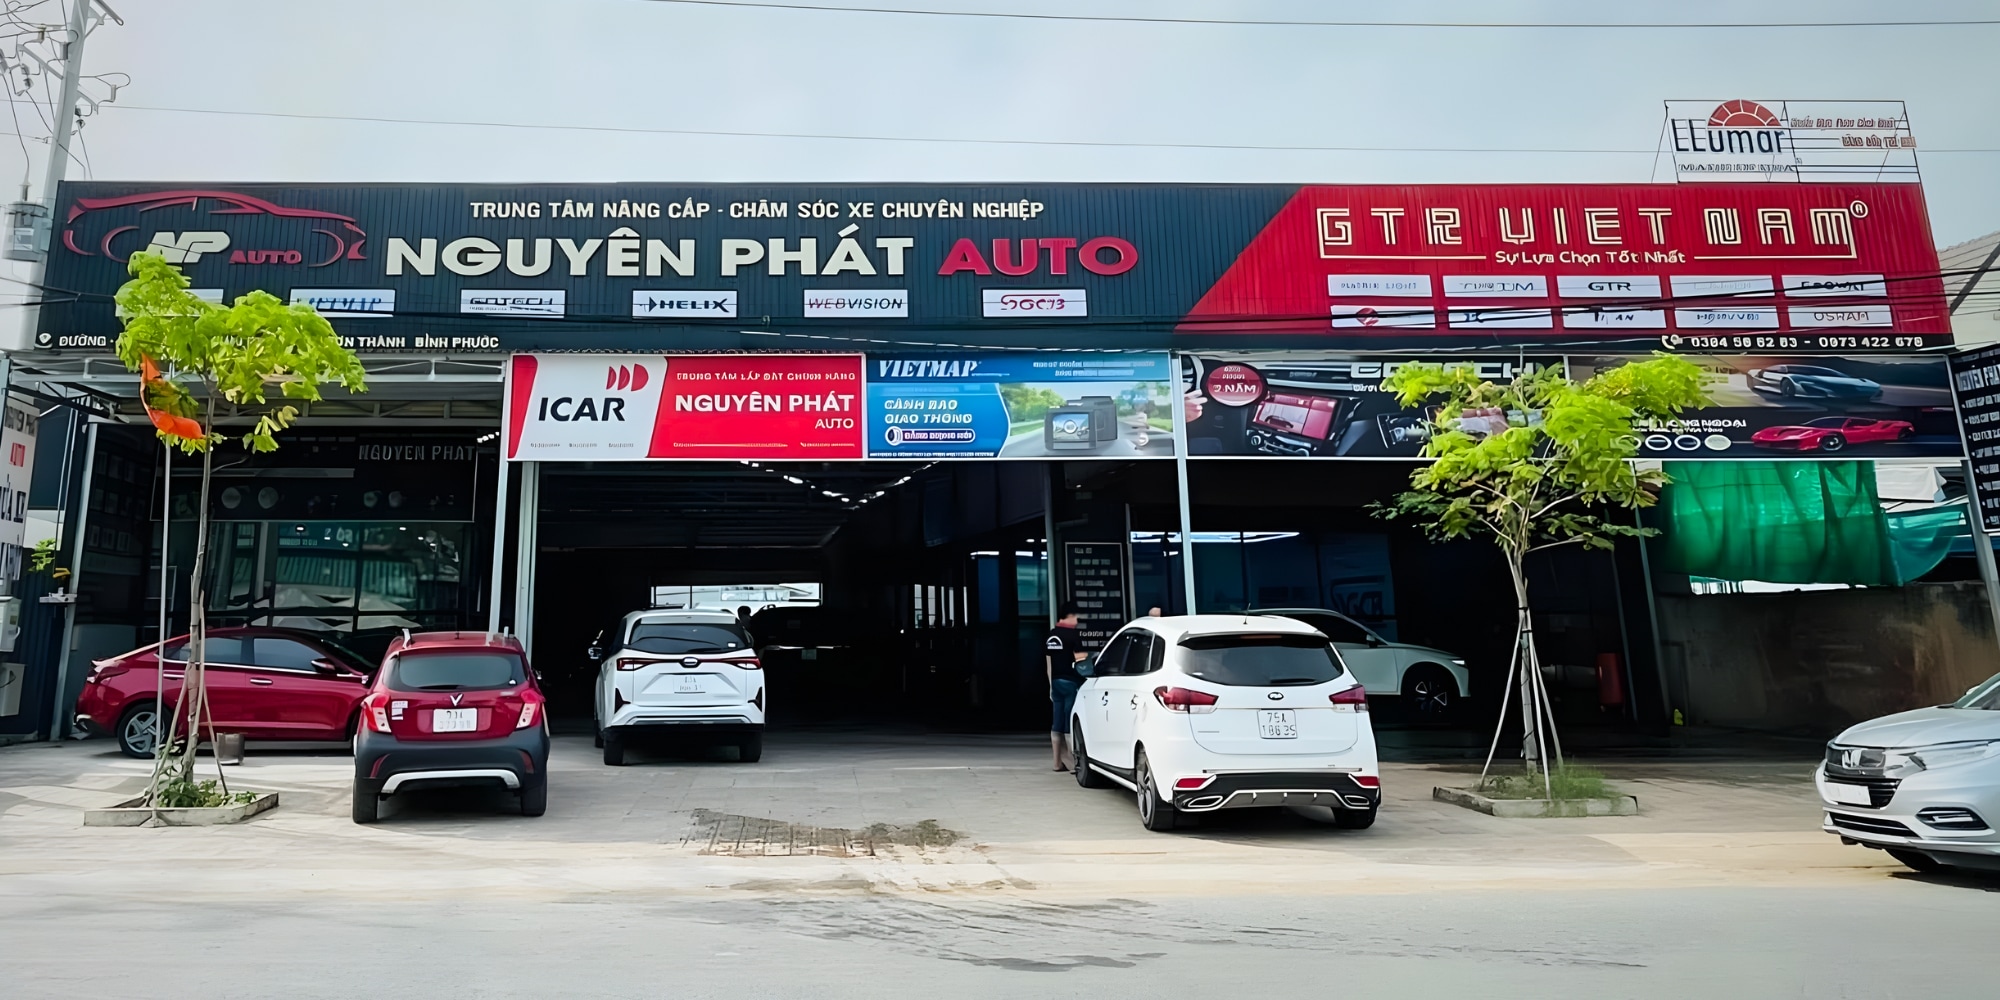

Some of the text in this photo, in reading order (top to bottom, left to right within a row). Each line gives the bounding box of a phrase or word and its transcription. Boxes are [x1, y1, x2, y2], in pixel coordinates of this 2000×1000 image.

[470, 202, 540, 218] TRUNG
[549, 200, 594, 218] TÂM
[602, 200, 660, 218] NÂNG
[668, 197, 710, 218] CẤP
[798, 200, 839, 218] SÓC
[848, 202, 874, 218] XE
[882, 199, 964, 218] CHUYÊN
[972, 199, 1044, 221] NGHIỆP
[1317, 208, 1462, 245] GTR
[229, 250, 302, 264] AUTO
[386, 223, 1138, 277] NGUYÊN PHÁT AUTO
[1560, 251, 1600, 266] Chọn
[1588, 281, 1631, 291] GTR
[659, 297, 730, 313] HELIX
[808, 297, 903, 310] WEBVISION
[880, 360, 977, 377] VIETMAP
[539, 397, 625, 421] ICAR
[675, 391, 854, 412] NGUYÊN PHÁT
[815, 418, 854, 429] AUTO
